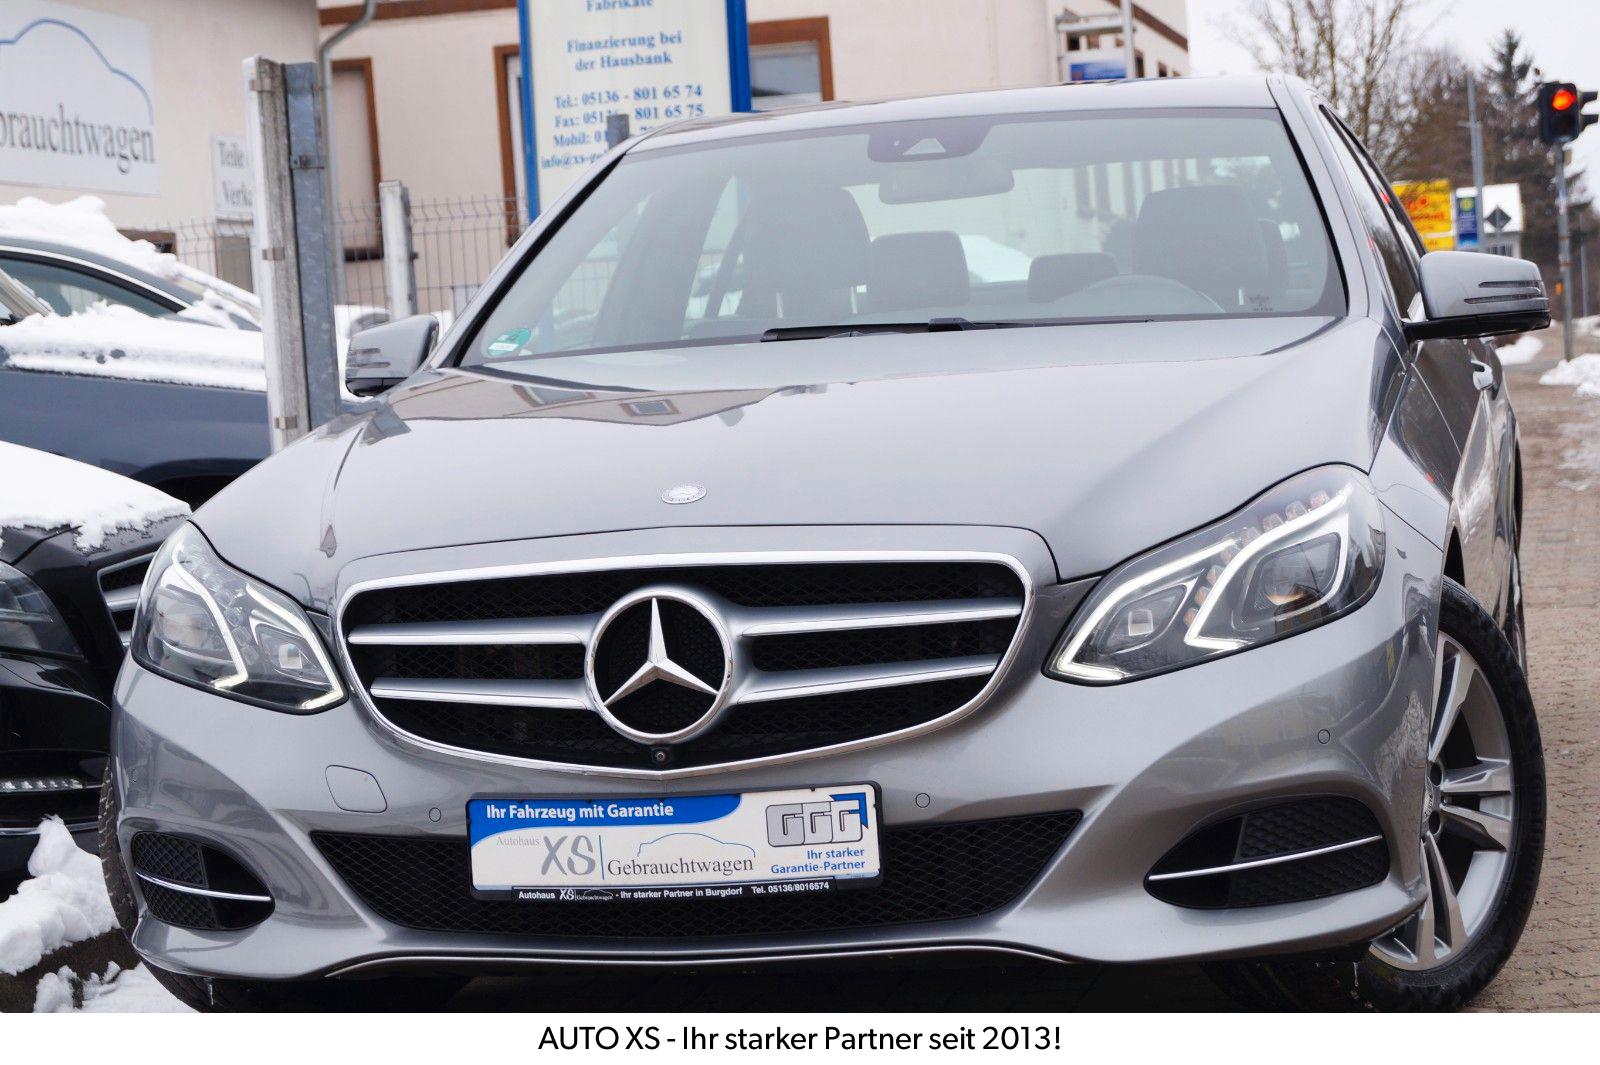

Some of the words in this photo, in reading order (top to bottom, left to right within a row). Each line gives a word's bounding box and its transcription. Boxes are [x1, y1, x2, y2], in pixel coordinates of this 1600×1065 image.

[586, 0, 654, 12] Fabrikate
[567, 34, 656, 52] Finanzierung
[660, 30, 682, 45] bei
[575, 58, 596, 71] der
[600, 51, 673, 68] Hausbank
[582, 89, 620, 105] 05136
[633, 87, 658, 101] 801
[664, 86, 680, 99] 65
[686, 84, 703, 97] 74
[555, 115, 578, 128] Fax:
[635, 107, 659, 121] 801
[665, 105, 682, 118] 65
[687, 104, 704, 117] 75
[554, 130, 589, 147] Mobil:
[487, 804, 506, 819] Ihr
[509, 804, 576, 822] Fahrzeug
[579, 804, 605, 818] mit
[607, 802, 675, 818] Garantie
[496, 836, 540, 847] Autohaus
[541, 835, 596, 876] XS
[807, 850, 823, 860] Ihr
[825, 847, 865, 859] starker
[607, 857, 753, 876] Gebrauchtwagen
[770, 860, 866, 875] Garantie-Partner
[518, 890, 556, 899] Autohaus
[559, 889, 575, 901] XS
[620, 890, 632, 899] Ihr
[633, 890, 662, 899] starker
[664, 888, 693, 898] Partner
[695, 889, 704, 897] in
[706, 887, 743, 897] Burgdorf
[751, 886, 766, 895] Tel.
[767, 881, 829, 895] 05136/8016574
